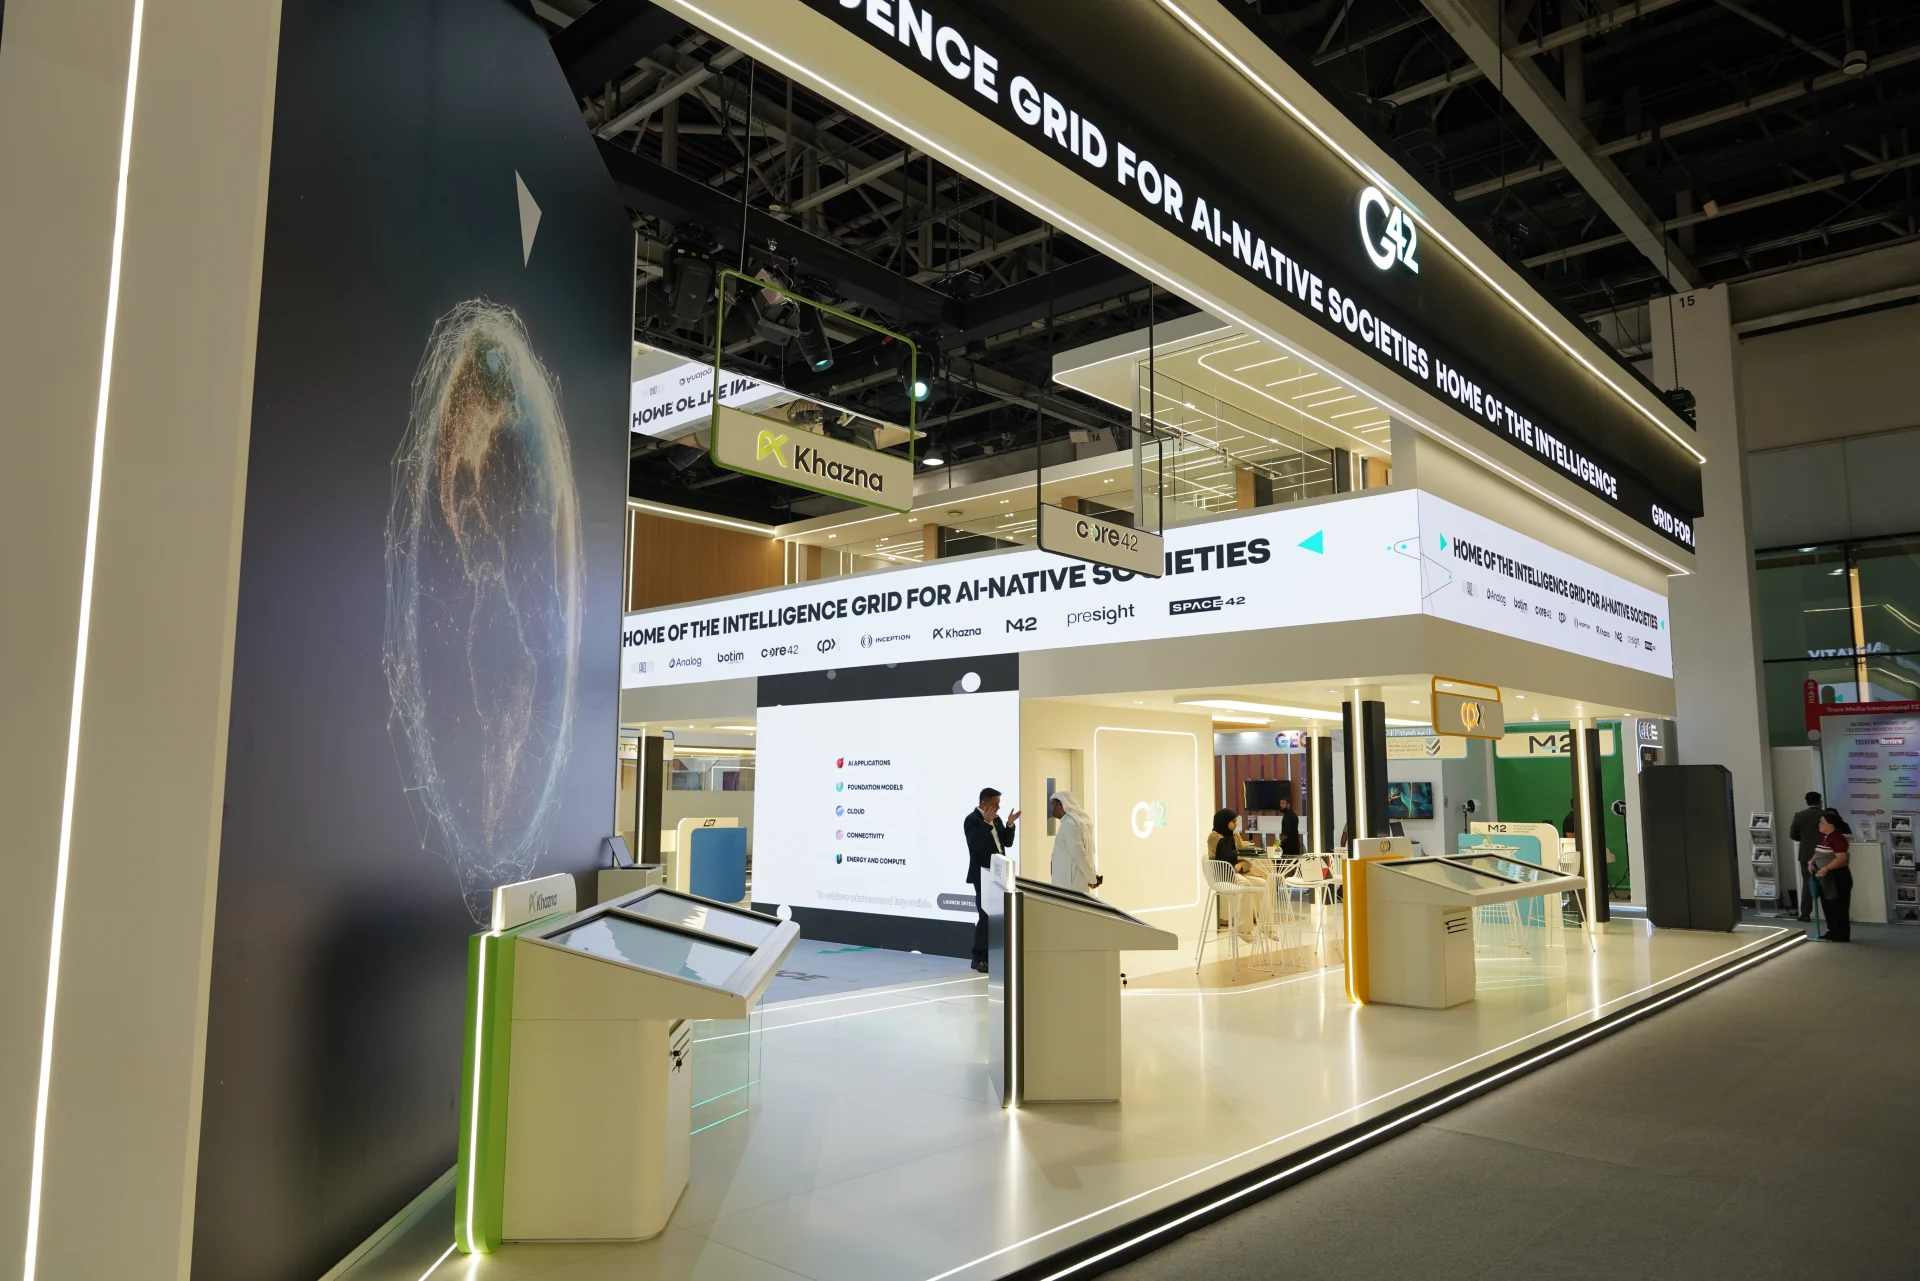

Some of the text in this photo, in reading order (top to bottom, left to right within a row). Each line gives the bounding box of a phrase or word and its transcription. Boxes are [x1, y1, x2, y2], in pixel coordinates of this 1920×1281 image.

[1010, 76, 1107, 168] GRID
[1118, 142, 1183, 223] FOR
[1191, 197, 1324, 313] AI-NATIVE
[1328, 287, 1429, 380] SOCIETIES
[1359, 186, 1419, 275] G42
[1679, 295, 1695, 308] 15
[1092, 433, 1100, 442] 16
[1436, 359, 1483, 415] HOME
[1485, 394, 1503, 426] OF
[1505, 406, 1533, 448] THE
[1535, 426, 1618, 500] INTELLIGENCE
[1651, 504, 1673, 534] GRID
[1674, 519, 1691, 547] FOR
[794, 445, 883, 493] Khazna
[623, 538, 1271, 648] HOME OF THE INTELLIGENCE GRID FOR AI-NATIVE SOIETIES
[1453, 537, 1658, 630] HOME OF THE INTELLIGENCE GRID FOR AI-NATIVE SOCIETIES
[1067, 603, 1135, 627] presight
[875, 634, 911, 643] INCEPTION
[945, 627, 982, 639] Khazna
[676, 656, 702, 668] Analog
[717, 650, 744, 663] botim
[1866, 704, 1910, 712] International
[1131, 800, 1167, 838] G42
[536, 893, 557, 912] Khazna
